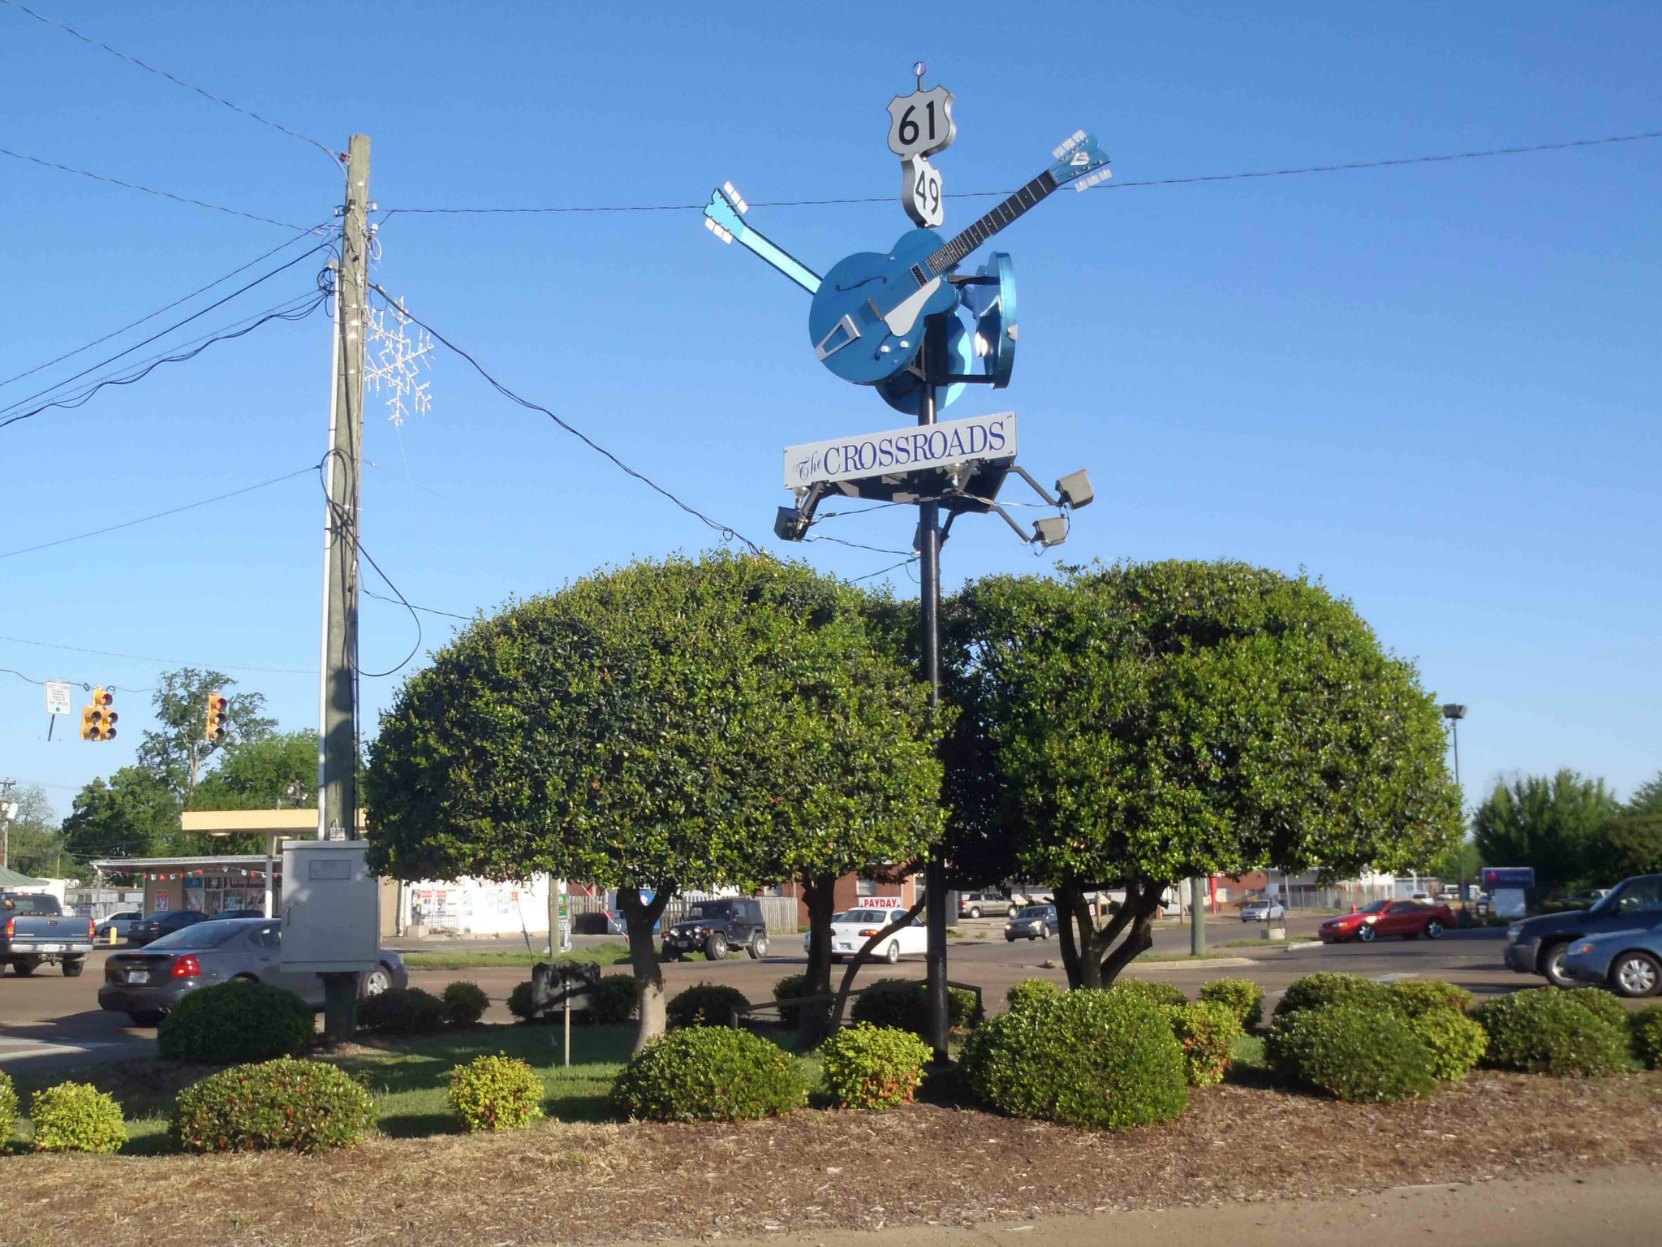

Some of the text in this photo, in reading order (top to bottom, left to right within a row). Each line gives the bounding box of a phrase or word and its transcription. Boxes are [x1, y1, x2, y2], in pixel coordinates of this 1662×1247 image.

[898, 100, 935, 145] 61
[915, 170, 939, 215] 49
[792, 421, 1006, 481] The CROSSROADS
[863, 899, 897, 908] PAYDAY
